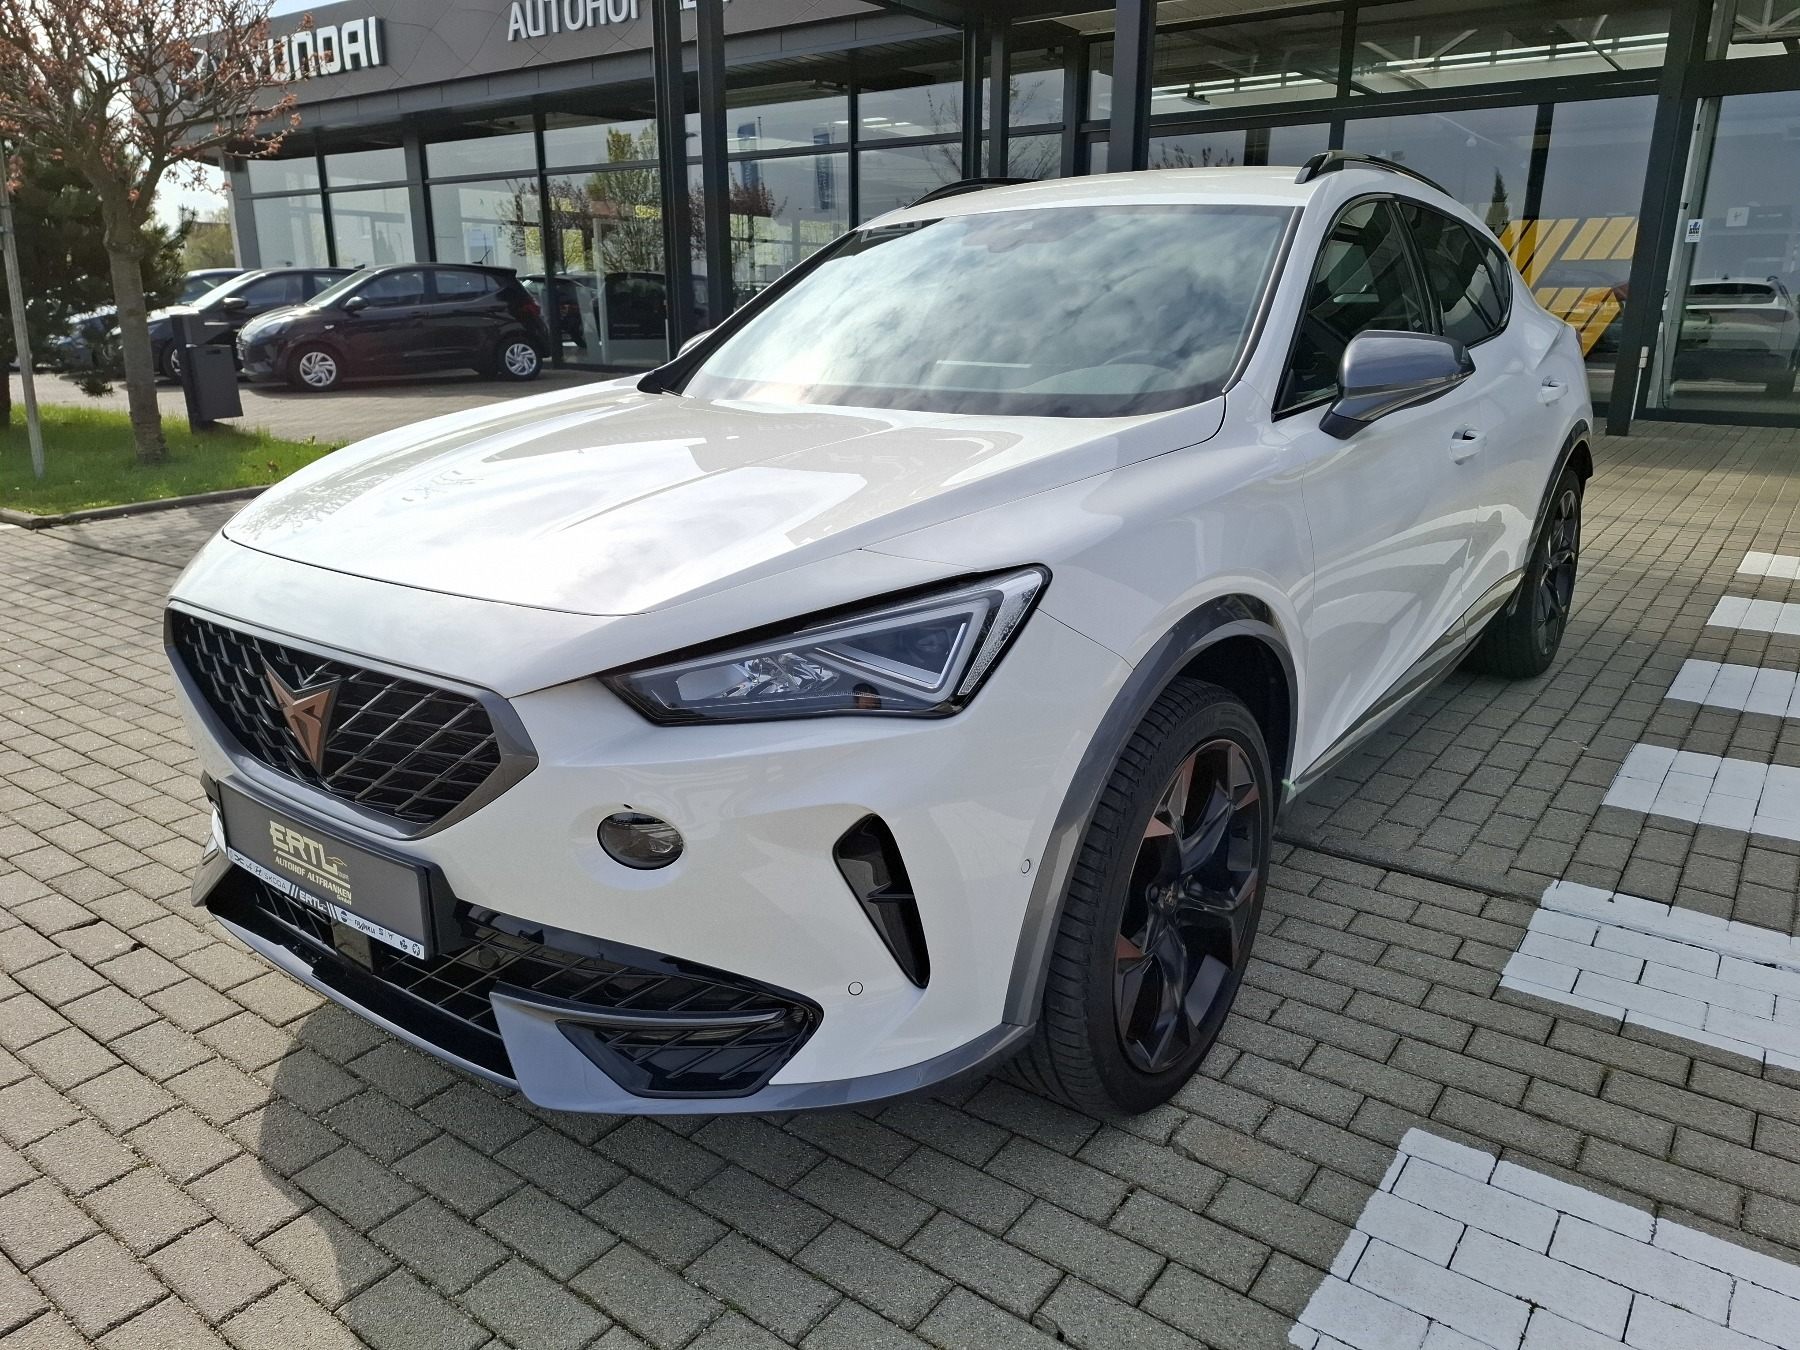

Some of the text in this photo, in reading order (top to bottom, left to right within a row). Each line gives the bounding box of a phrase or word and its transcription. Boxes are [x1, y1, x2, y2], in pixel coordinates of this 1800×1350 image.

[224, 16, 380, 88] UNDAI
[269, 820, 339, 875] ERTL
[275, 856, 306, 877] AUTOHOF
[307, 872, 352, 900] ALTFRANKEN
[299, 889, 323, 910] ERTL
